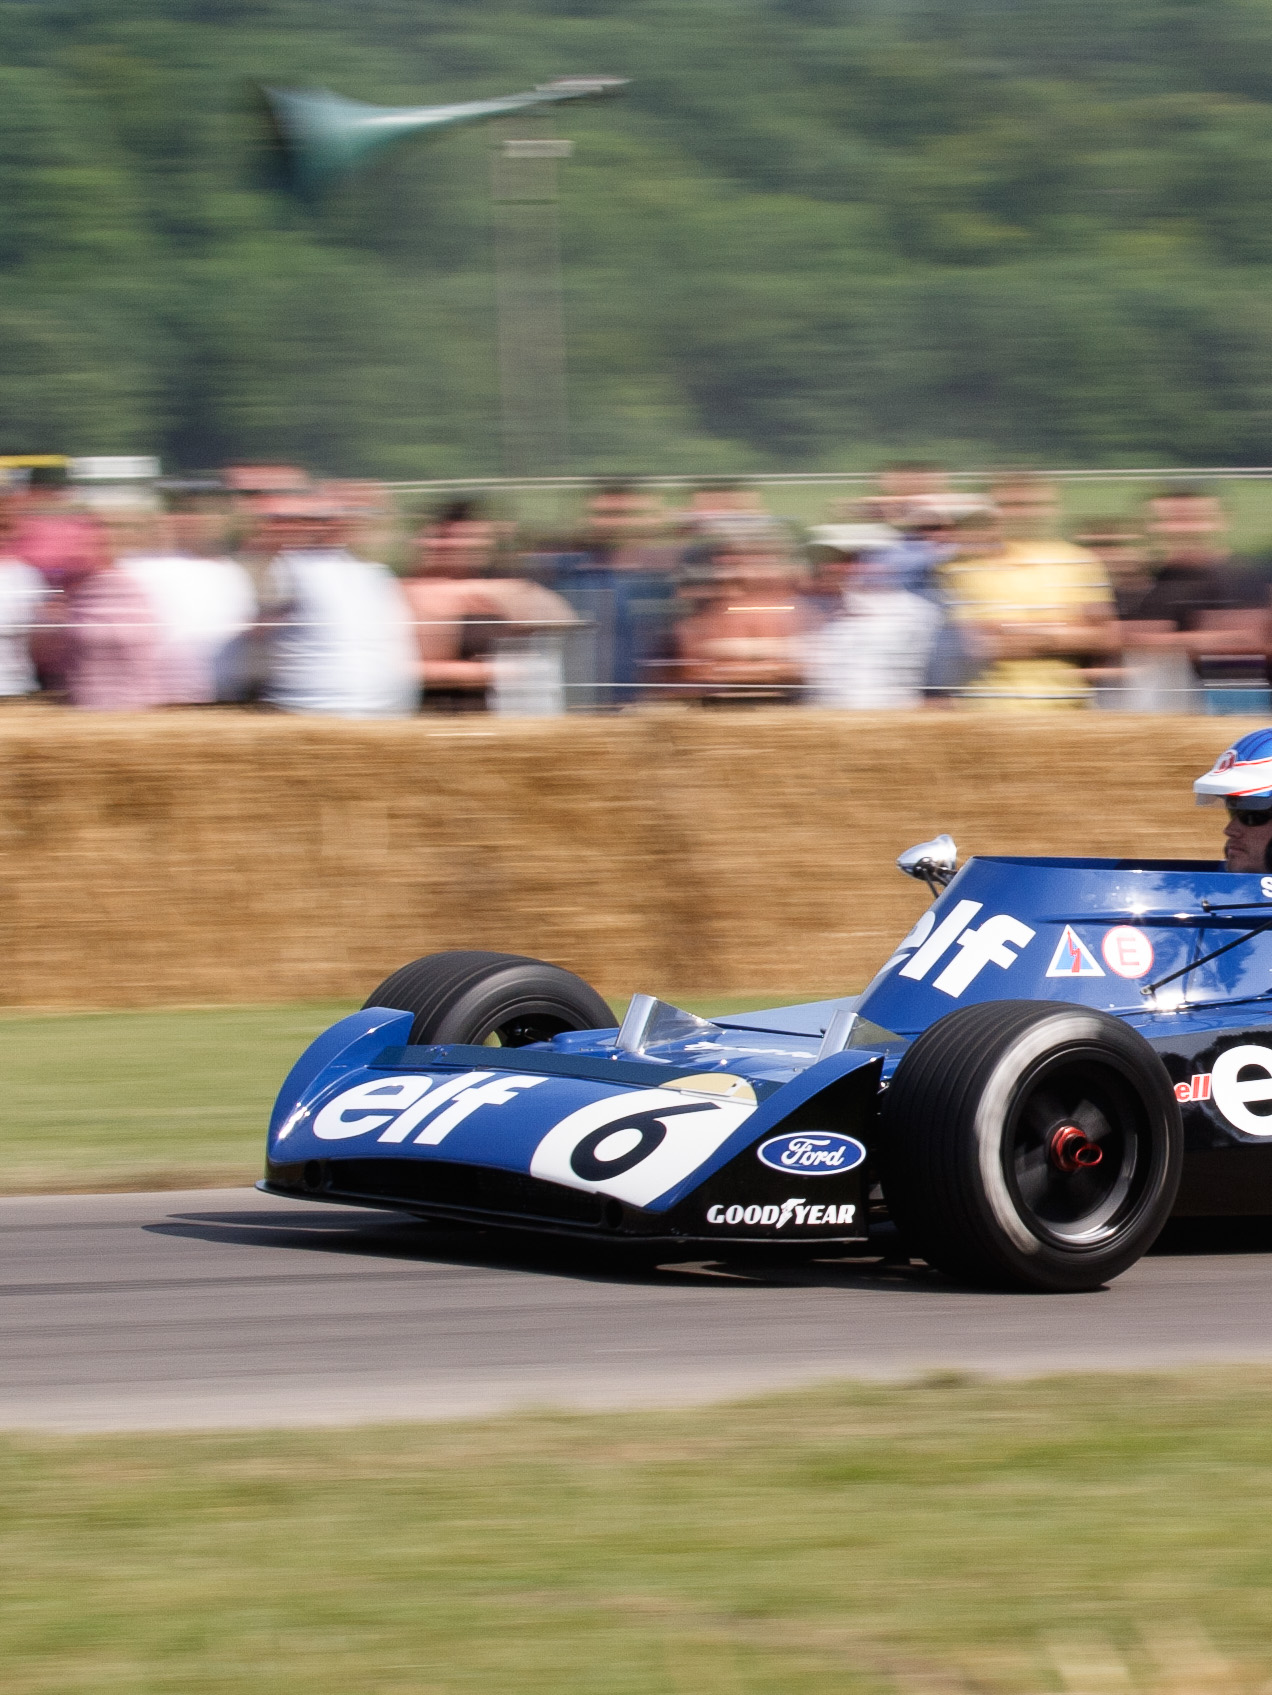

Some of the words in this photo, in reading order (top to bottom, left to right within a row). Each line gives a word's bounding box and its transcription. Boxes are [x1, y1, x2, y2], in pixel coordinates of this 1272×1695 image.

[1117, 937, 1140, 966] E
[312, 1071, 549, 1145] elf
[570, 1101, 722, 1182] 6
[780, 1137, 848, 1169] Ford
[706, 1198, 856, 1229] GOODYEAR
